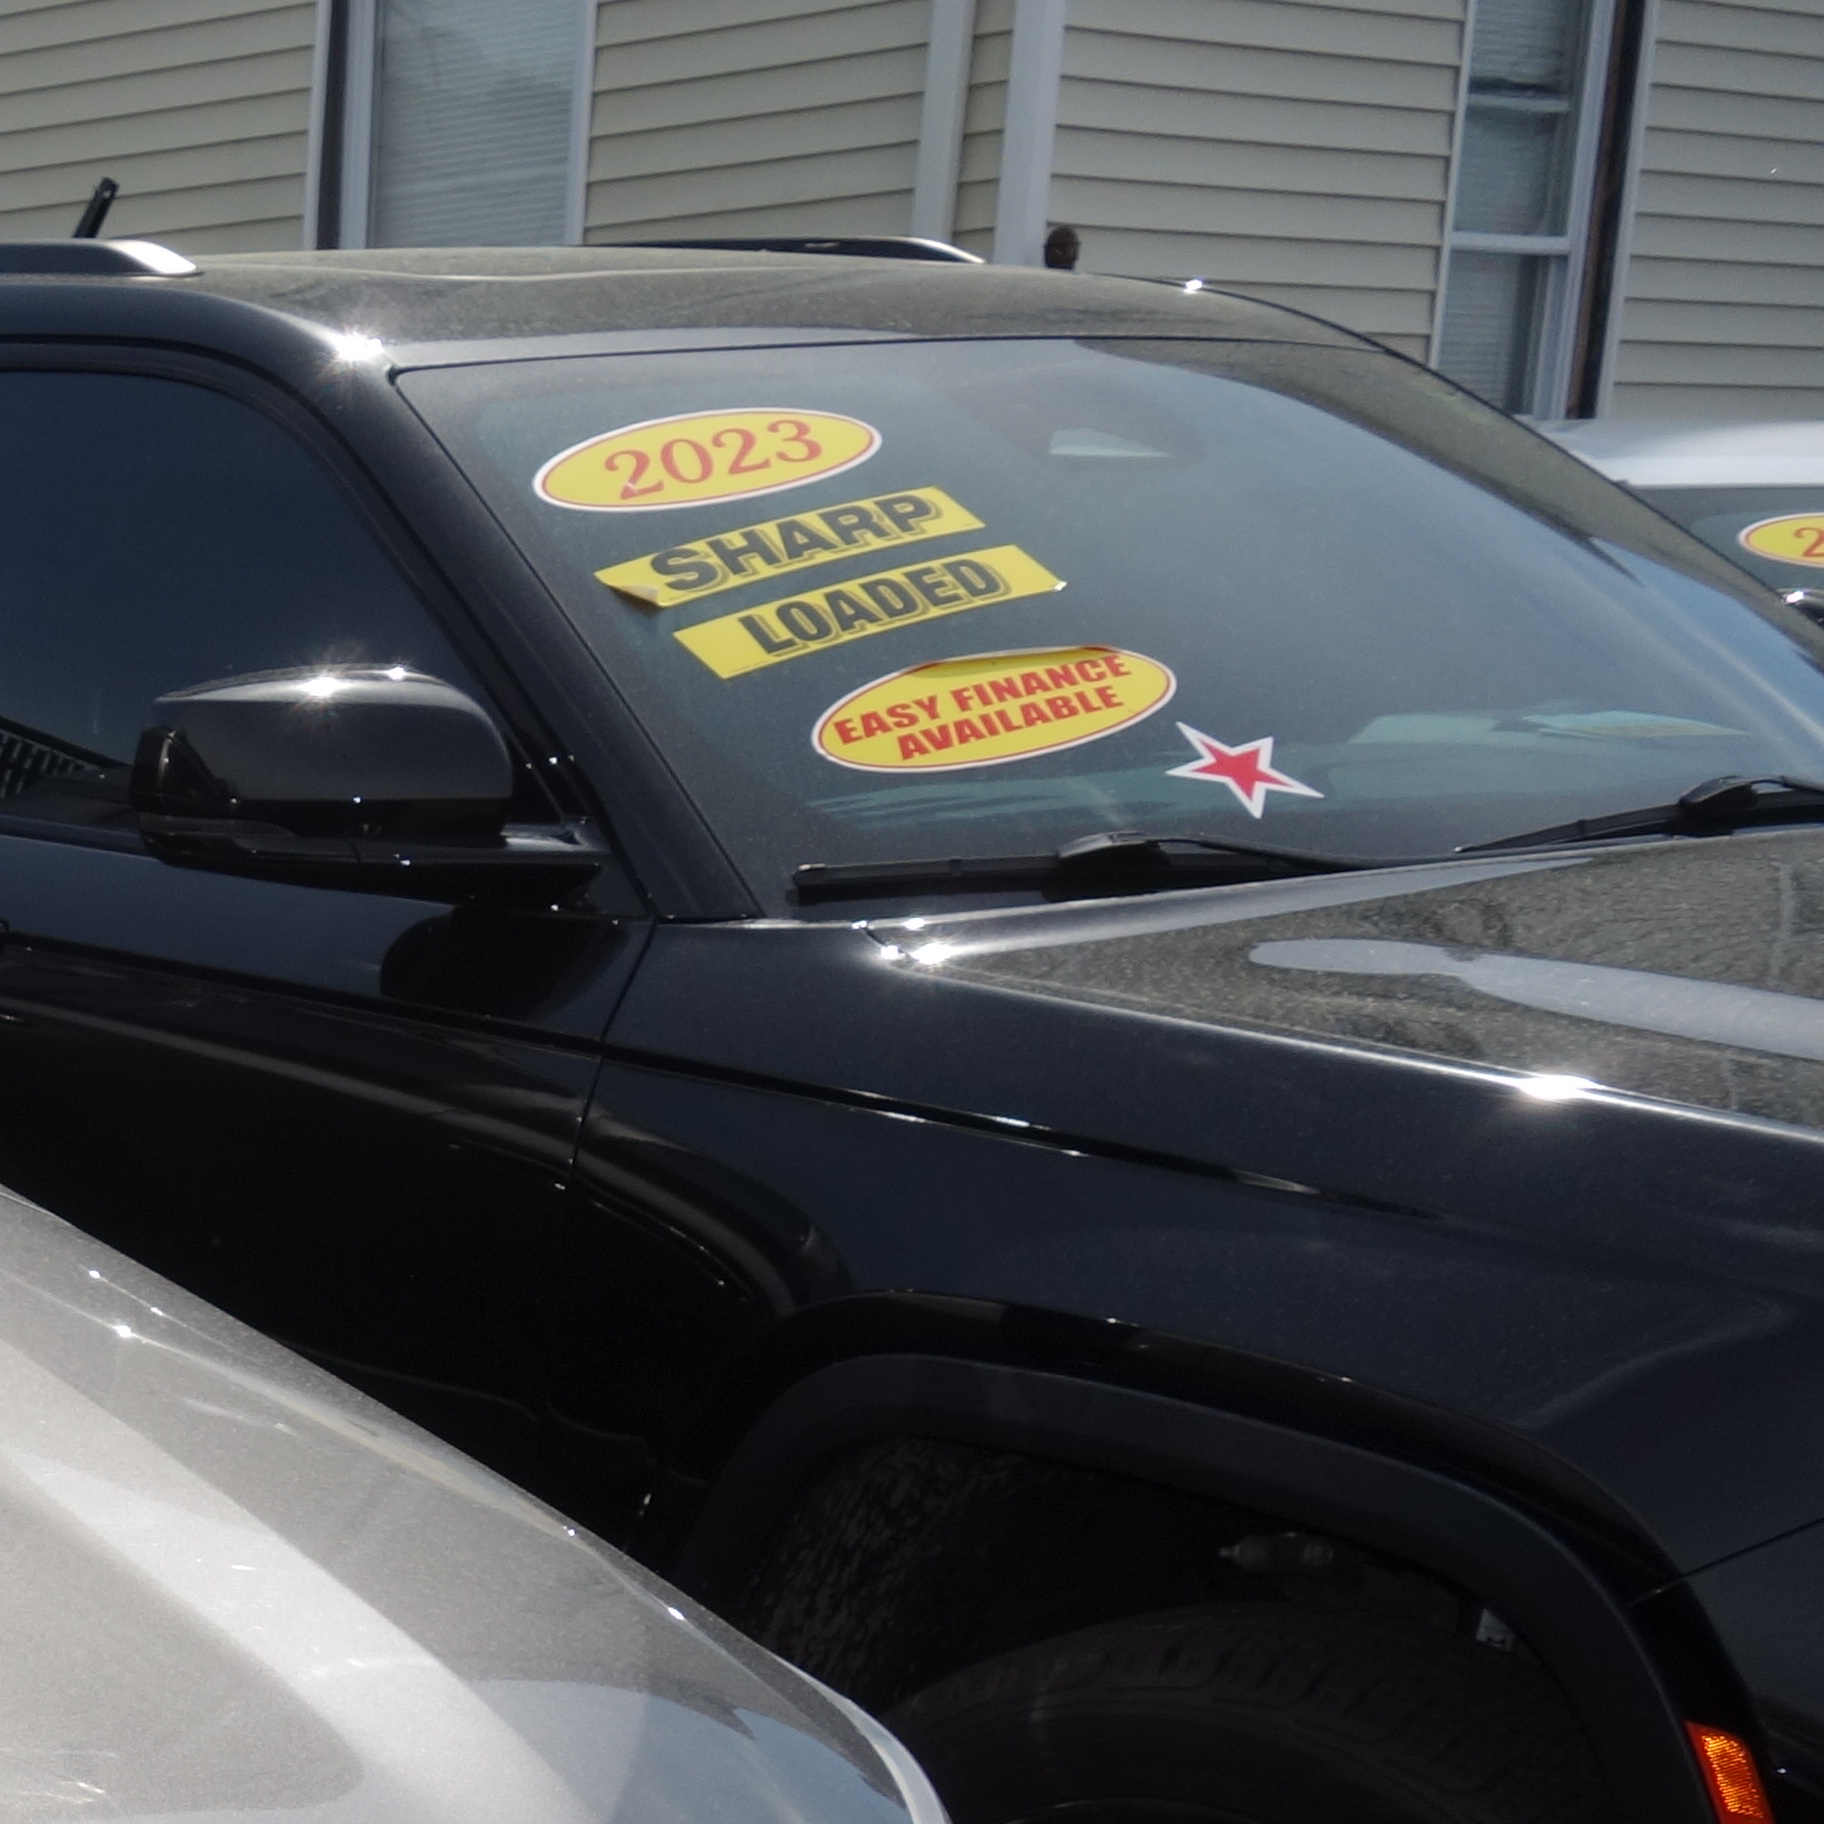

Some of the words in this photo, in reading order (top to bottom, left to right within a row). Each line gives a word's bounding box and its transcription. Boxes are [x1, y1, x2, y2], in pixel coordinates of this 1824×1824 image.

[603, 418, 825, 501] 2023
[650, 494, 941, 593] SHARP
[737, 556, 1008, 658] LOADED
[832, 694, 942, 745] EASY
[950, 653, 1133, 713] FINANCE
[896, 684, 1125, 761] AVAILABLE
